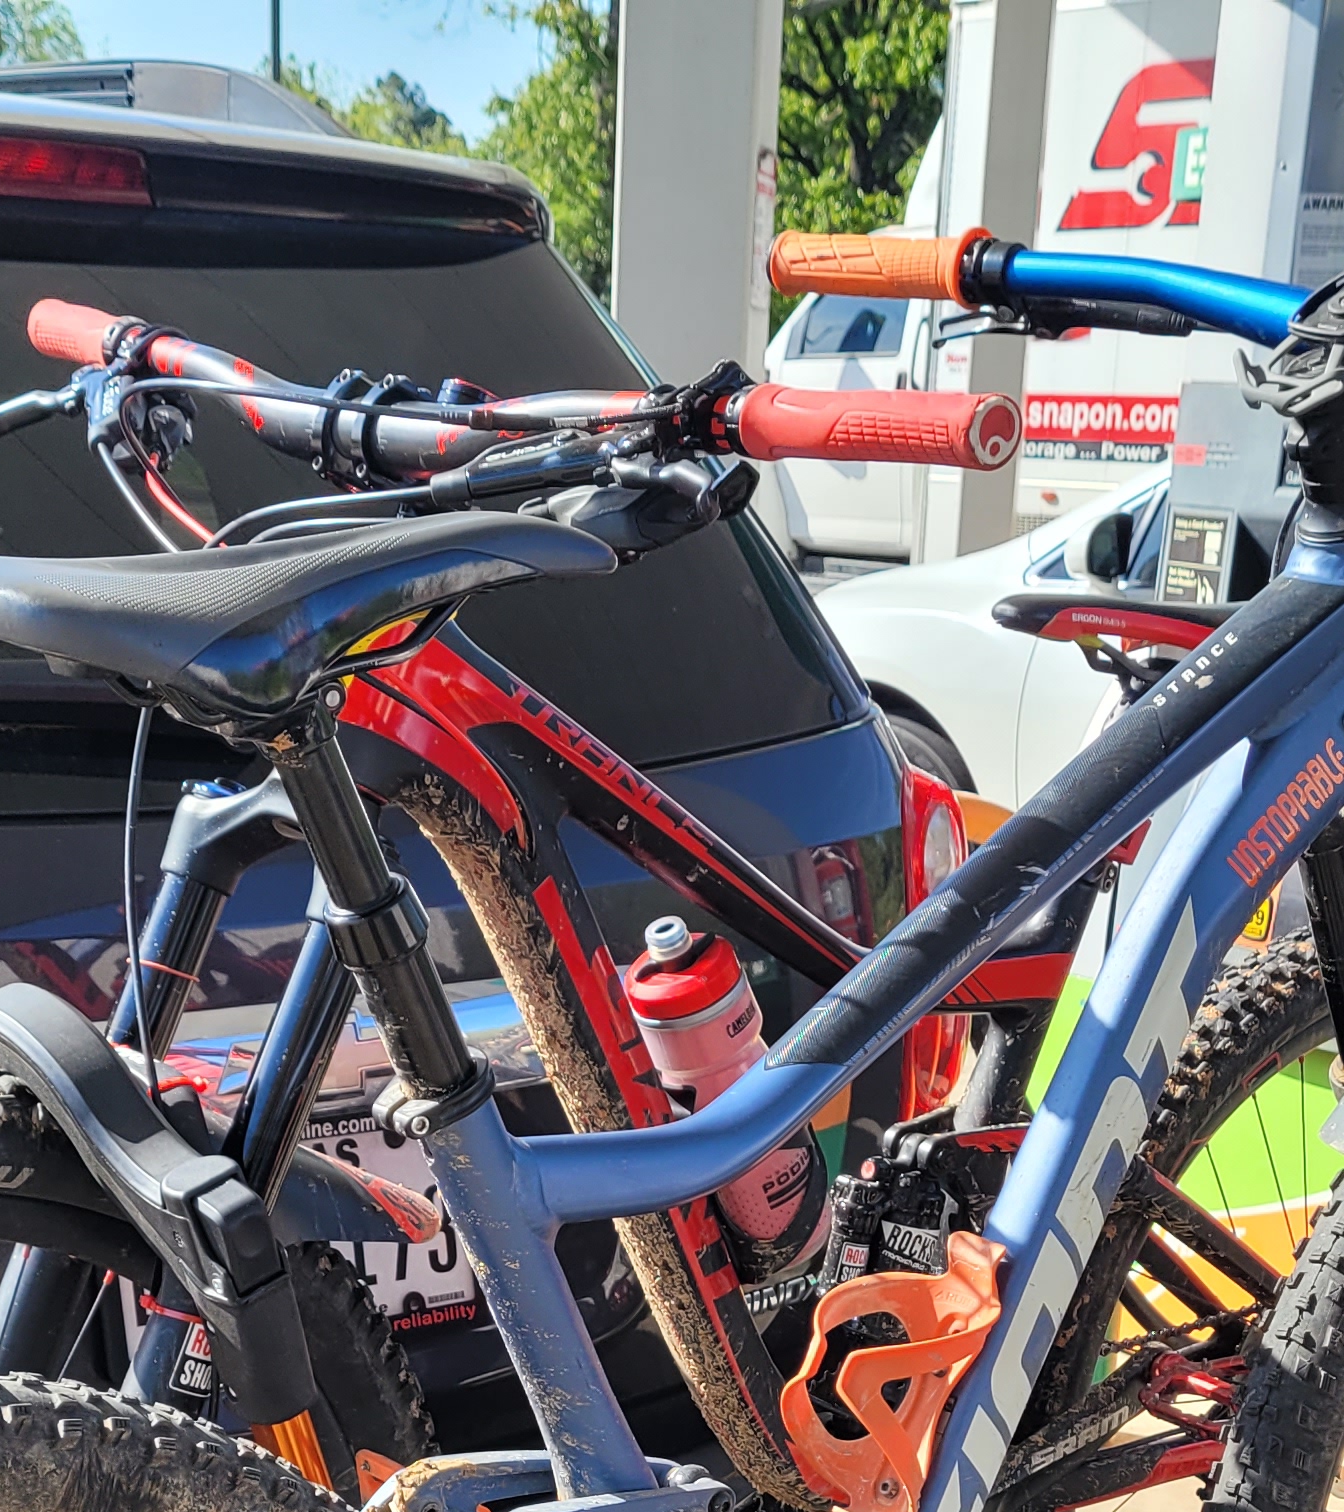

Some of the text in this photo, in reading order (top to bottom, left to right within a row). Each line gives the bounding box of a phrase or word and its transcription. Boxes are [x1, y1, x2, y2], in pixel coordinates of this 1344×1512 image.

[1101, 441, 1161, 462] Power
[1071, 612, 1104, 625] ERGON
[1152, 631, 1240, 708] STANCE
[887, 1224, 938, 1263] ROCKS
[392, 1303, 477, 1332] reliability
[179, 1359, 213, 1391] SHO
